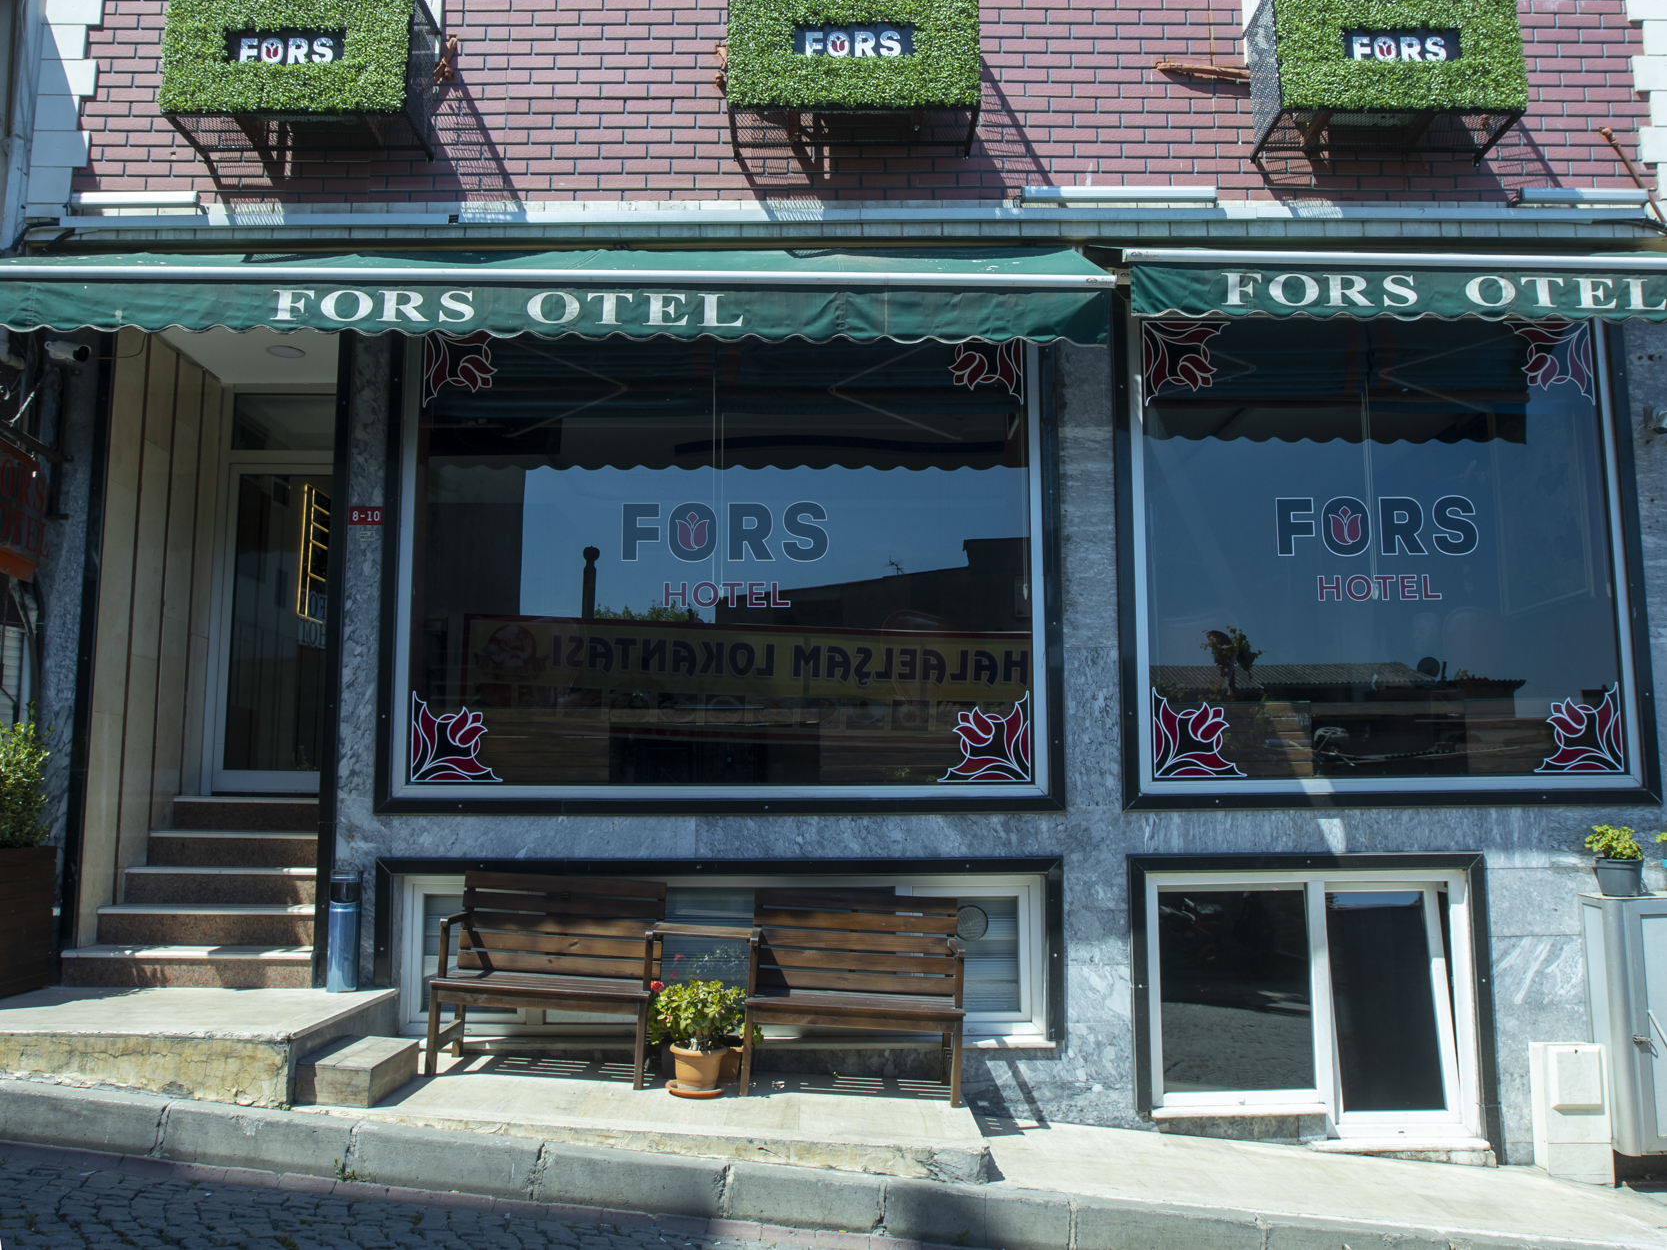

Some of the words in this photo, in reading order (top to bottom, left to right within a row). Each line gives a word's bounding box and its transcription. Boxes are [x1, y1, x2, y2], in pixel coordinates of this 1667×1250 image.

[238, 37, 334, 64] FORS
[805, 31, 901, 57] FORS
[1352, 36, 1447, 62] FORS
[1221, 272, 1418, 308] FORS
[1465, 275, 1667, 310] OTEL
[269, 289, 475, 323] FORS
[526, 291, 744, 328] OTEL
[352, 511, 381, 522] 8-10
[1275, 494, 1479, 556] FORS
[621, 501, 830, 563] FORS
[662, 581, 791, 608] HOTEL
[1317, 574, 1443, 602] HOTEL
